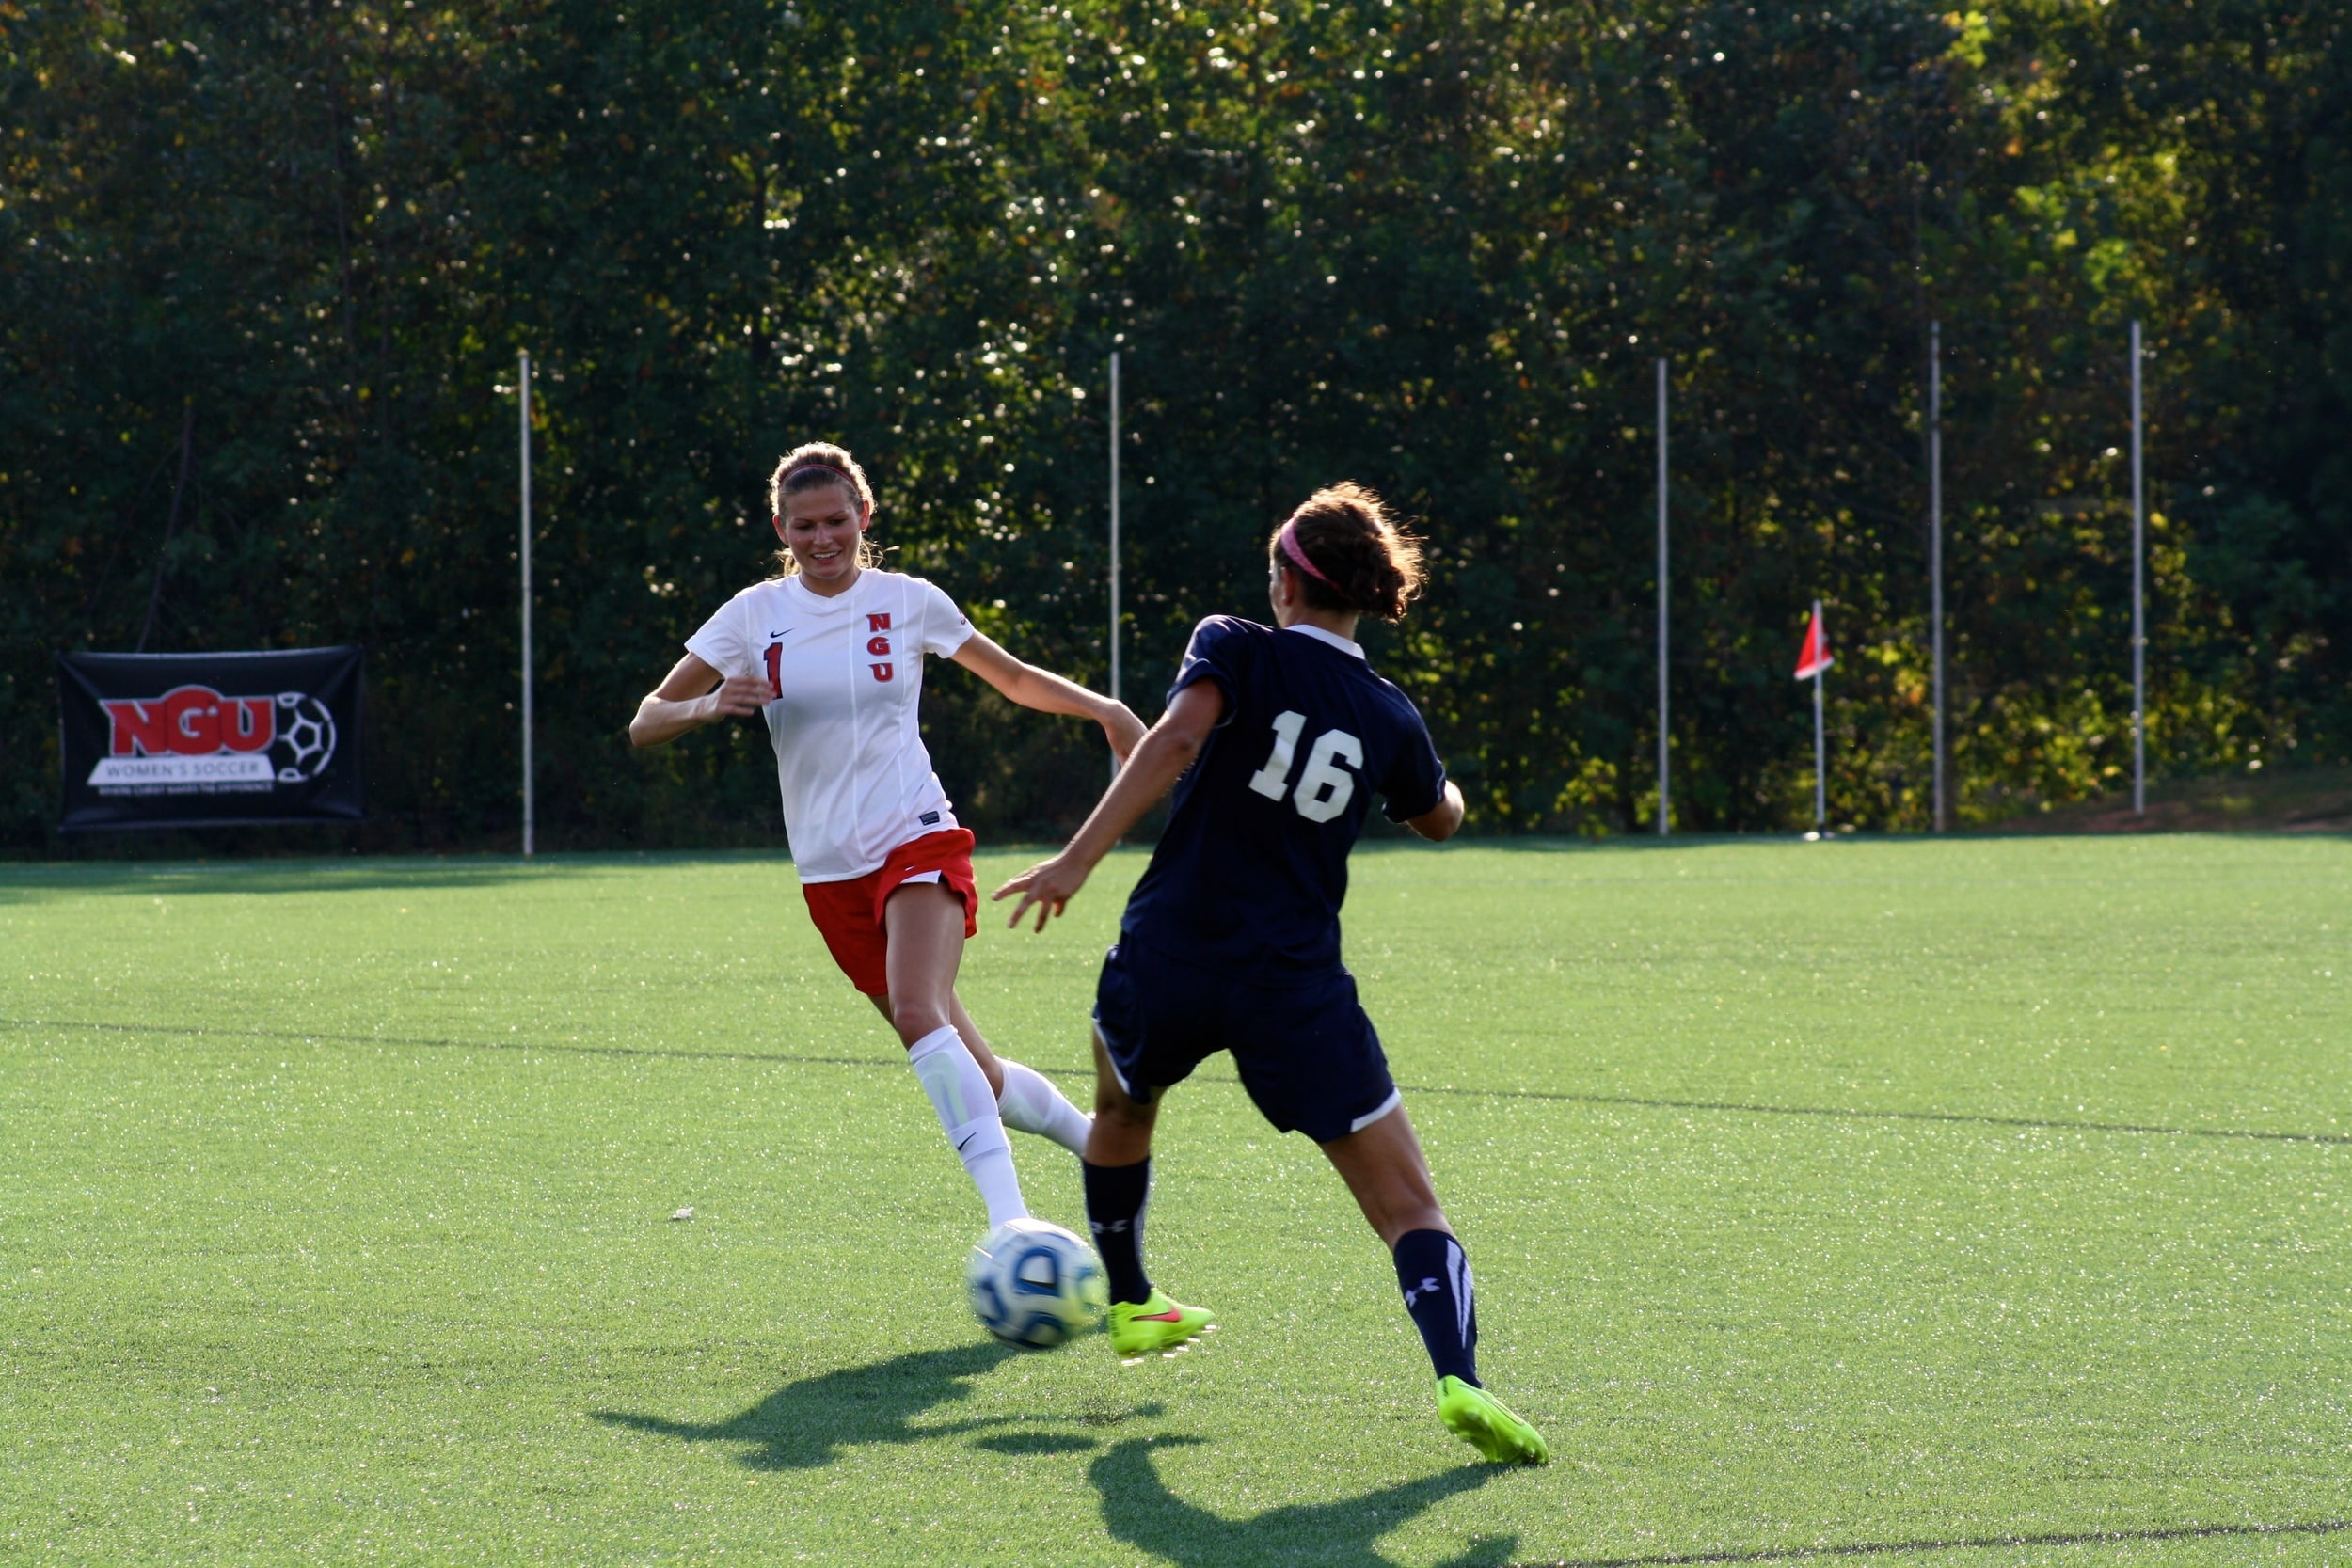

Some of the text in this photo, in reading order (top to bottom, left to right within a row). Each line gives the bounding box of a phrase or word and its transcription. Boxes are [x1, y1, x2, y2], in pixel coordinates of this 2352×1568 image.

[763, 641, 783, 700] 1
[866, 612, 893, 683] NGU
[99, 684, 276, 756] NGU
[106, 761, 260, 778] WOMEN'S SOCCER
[1248, 710, 1363, 823] 16
